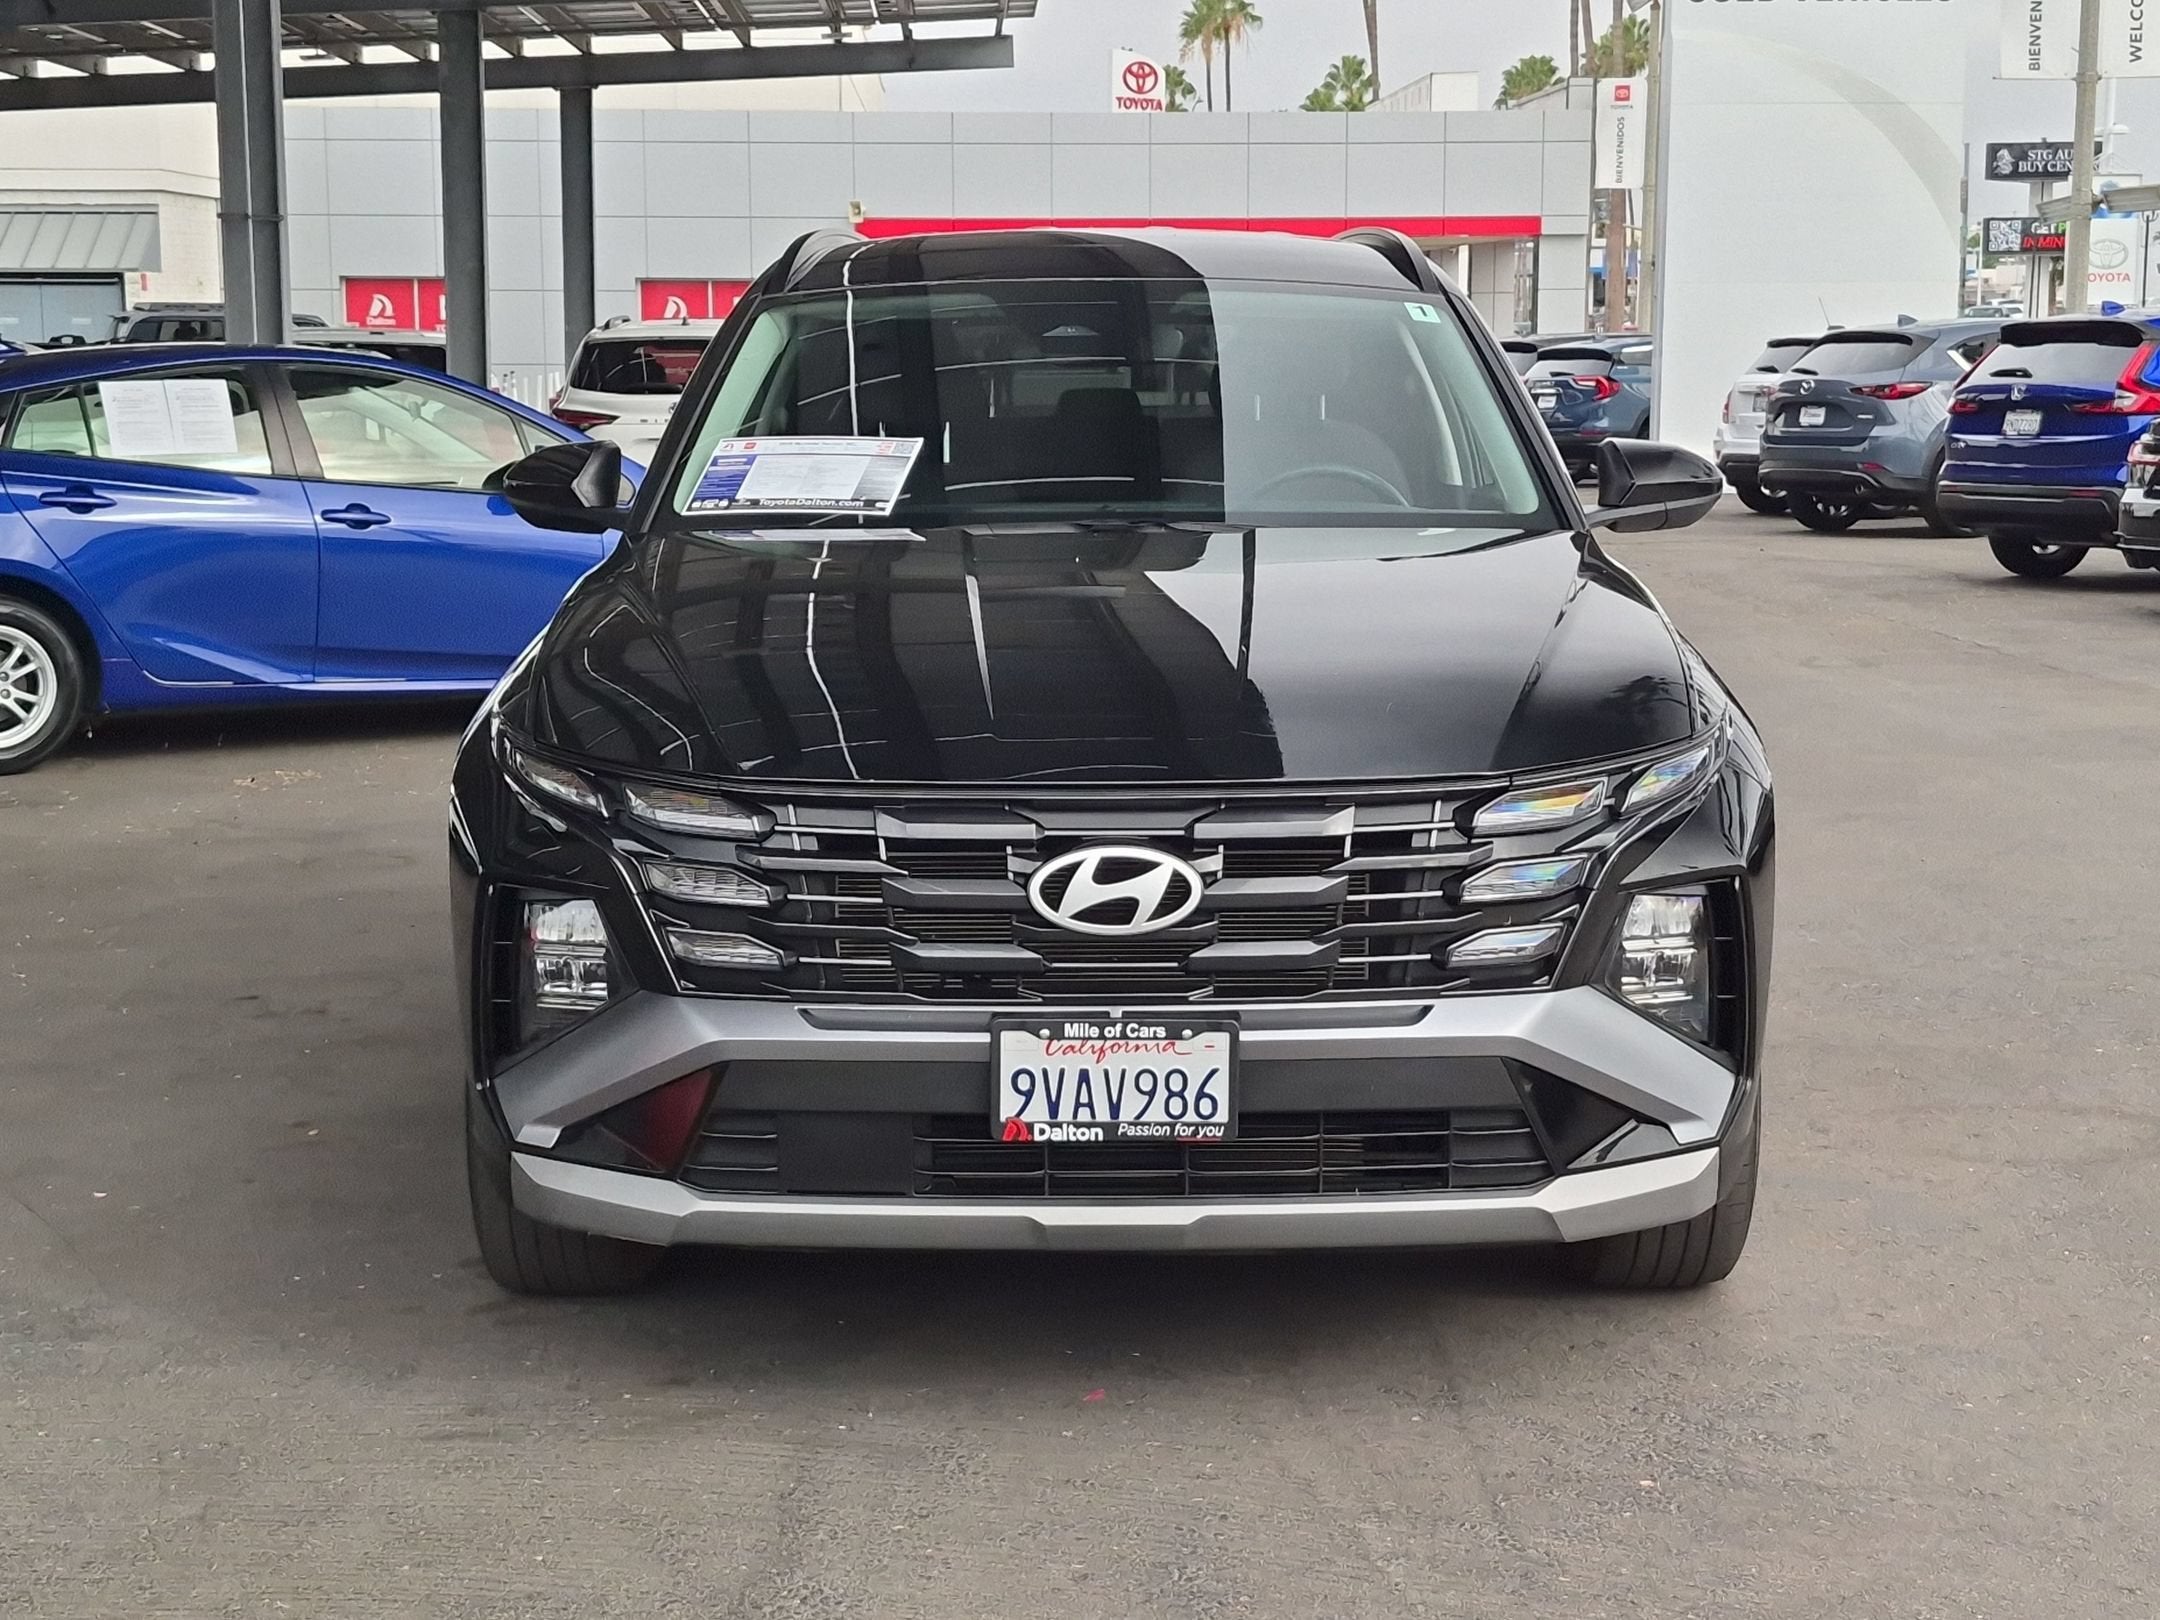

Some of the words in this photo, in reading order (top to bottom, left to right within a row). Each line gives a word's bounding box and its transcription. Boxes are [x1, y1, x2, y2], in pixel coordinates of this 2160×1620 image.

[2029, 1, 2042, 71] BIENVEN
[1115, 96, 1163, 111] TOYOTA
[1615, 116, 1625, 184] BIENVENIDOS
[2027, 149, 2053, 160] STG
[2018, 160, 2045, 172] BUY
[759, 498, 864, 508] ToyotaDalton.com
[1064, 1023, 1099, 1038] Mile
[1103, 1023, 1122, 1038] of
[1126, 1024, 1166, 1038] Cars
[1045, 1039, 1193, 1064] California
[1010, 1067, 1220, 1120] 9VAV986
[1034, 1123, 1103, 1141] Dalton
[1117, 1123, 1171, 1136] Passion
[1173, 1123, 1195, 1137] for
[1196, 1125, 1225, 1139] you
